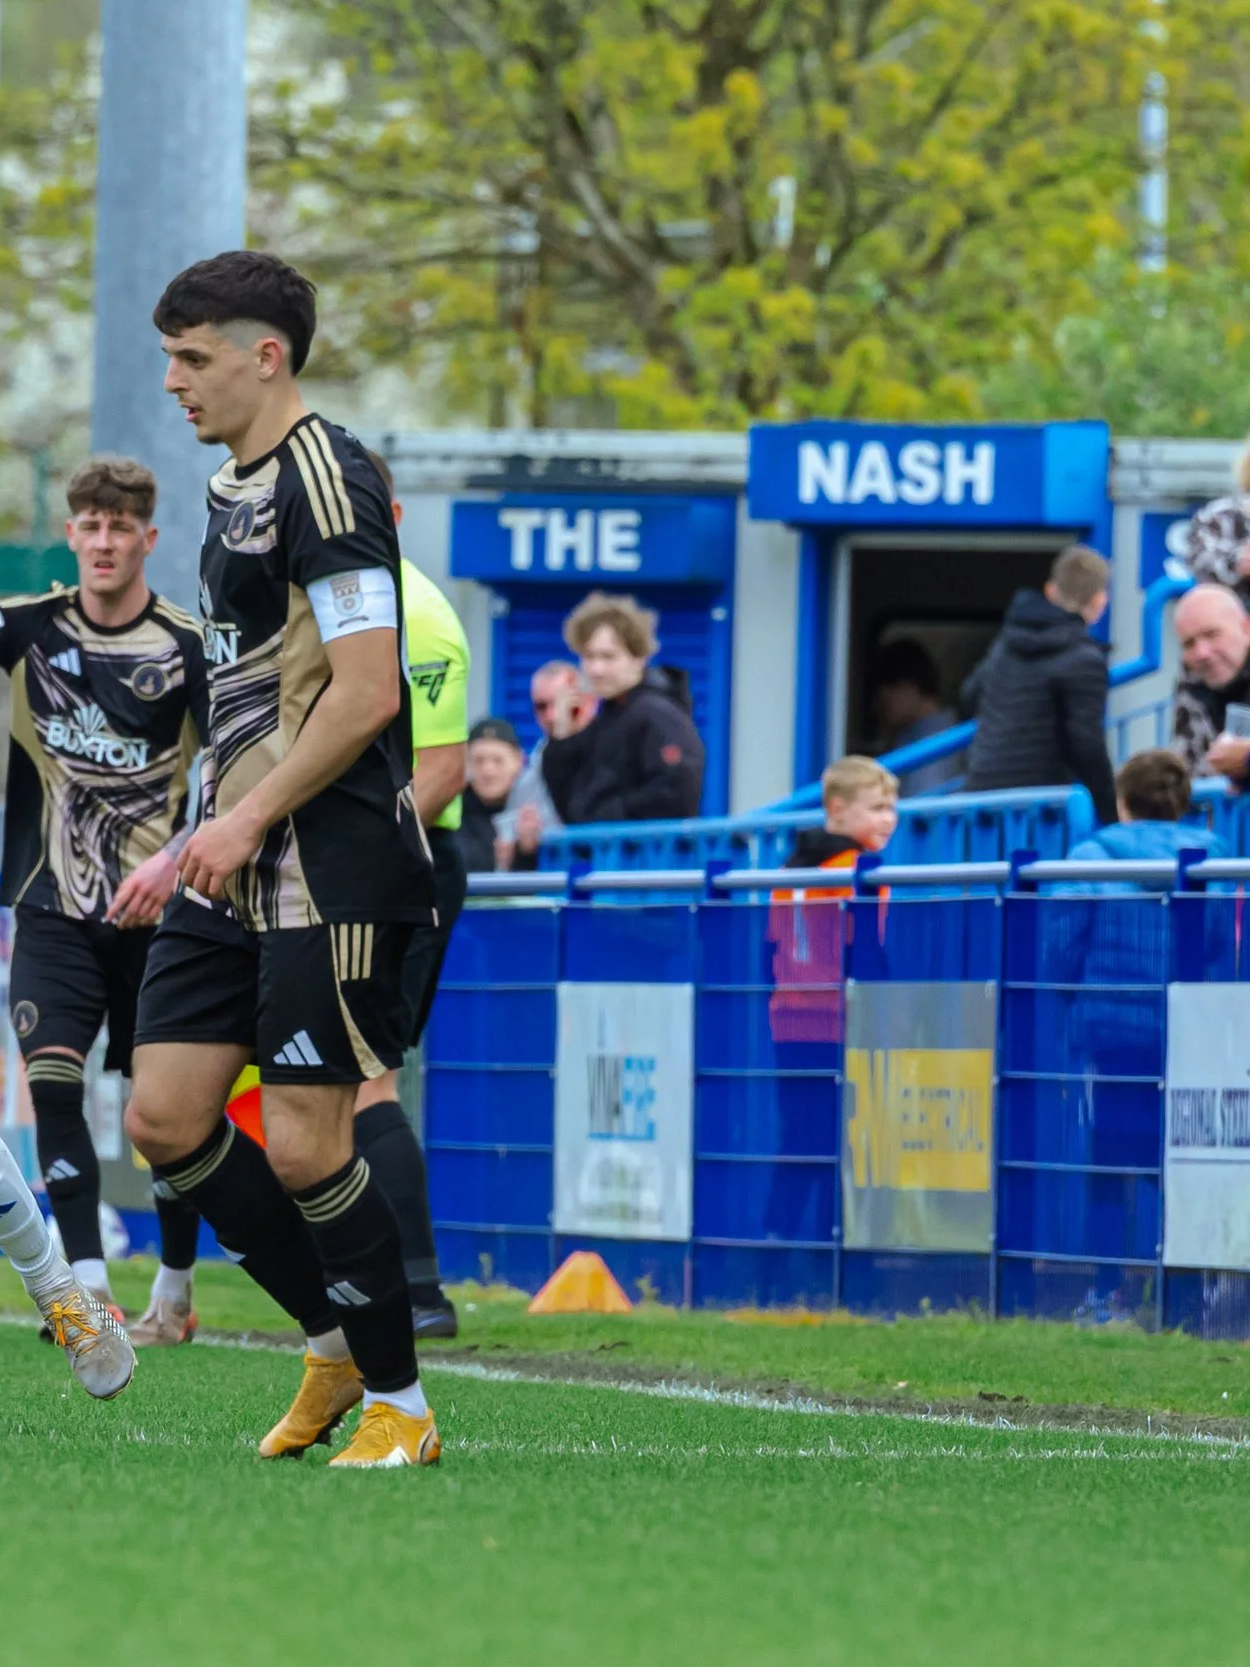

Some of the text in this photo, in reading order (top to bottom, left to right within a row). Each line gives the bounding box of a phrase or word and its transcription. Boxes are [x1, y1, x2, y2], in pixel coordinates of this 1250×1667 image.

[799, 442, 994, 504] NASH
[500, 509, 640, 570] THE
[47, 721, 148, 769] BUXTON
